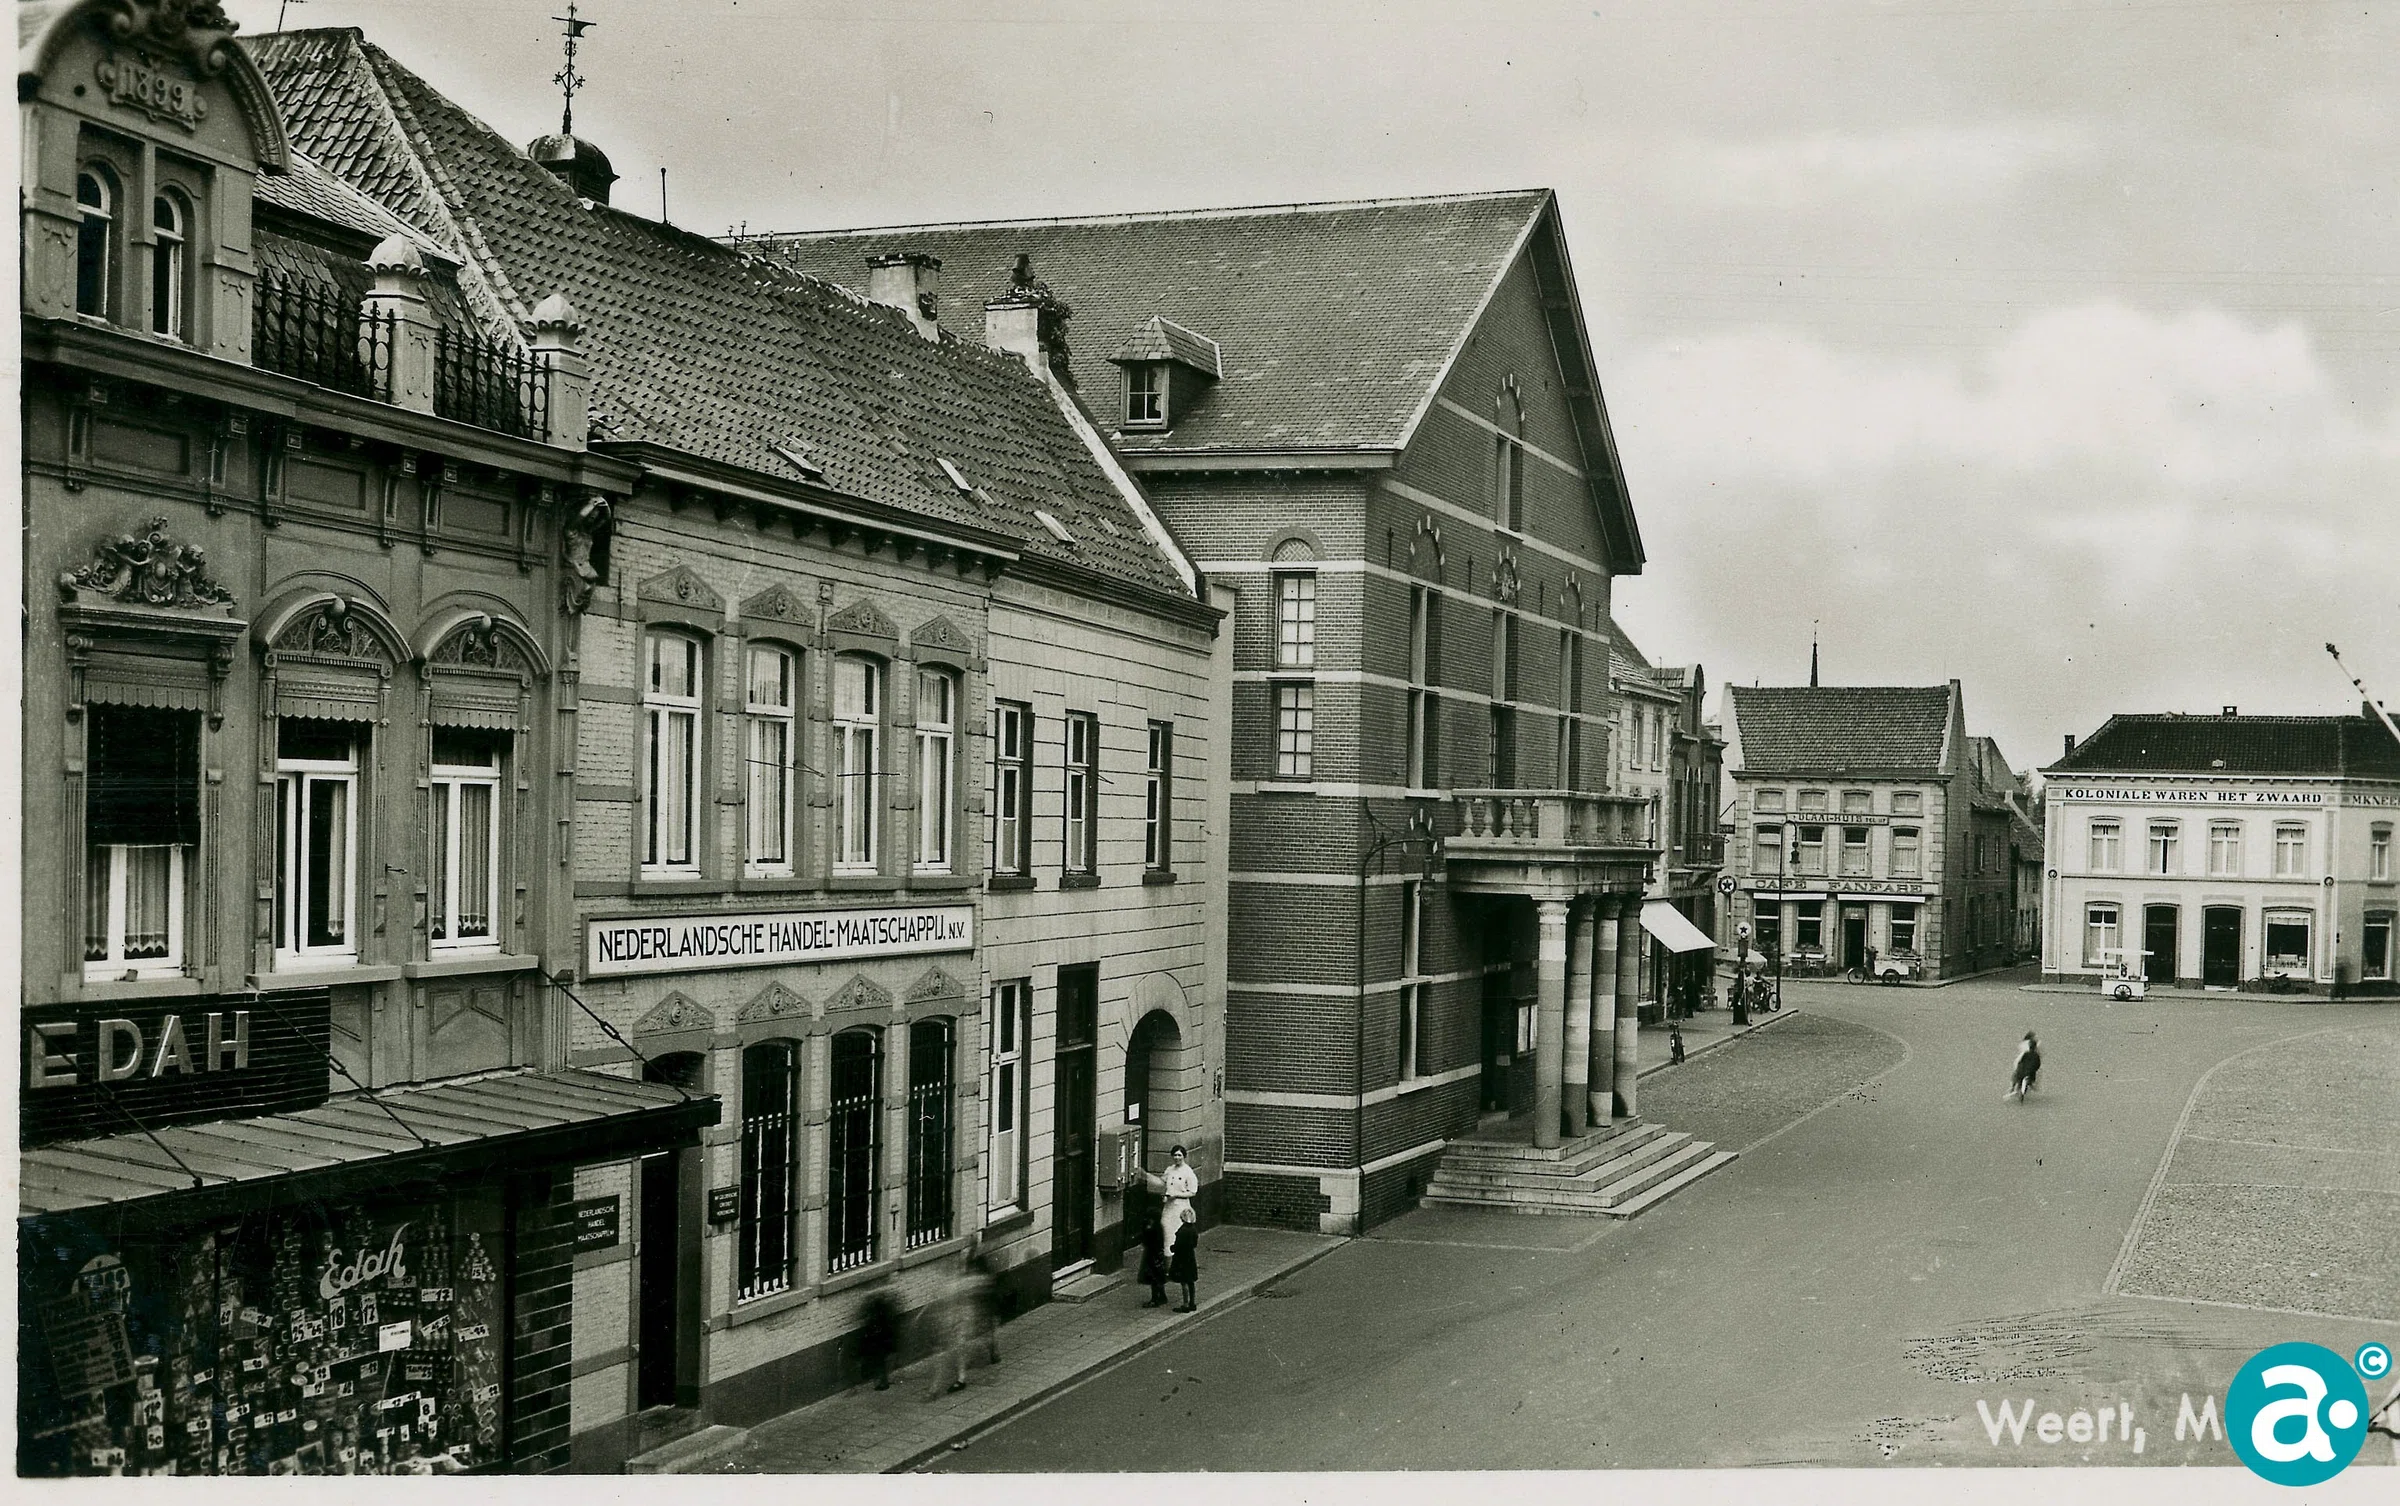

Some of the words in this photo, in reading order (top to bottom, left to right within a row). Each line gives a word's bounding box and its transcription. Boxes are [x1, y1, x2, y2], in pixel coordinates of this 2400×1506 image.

[124, 65, 185, 112] 1899
[2065, 789, 2150, 800] KOLONIALE
[2156, 792, 2208, 800] WAREN
[2218, 792, 2248, 801] HET
[2256, 793, 2322, 803] ZWAARD
[1828, 881, 1923, 893] FANFARE
[599, 924, 764, 962] NEDERLANDSCHE
[948, 921, 965, 940] N.V.
[30, 1011, 249, 1088] EDAH
[588, 1218, 605, 1228] HANDEL
[320, 1222, 411, 1300] Edah
[331, 1305, 344, 1328] 18
[422, 1403, 430, 1415] 8
